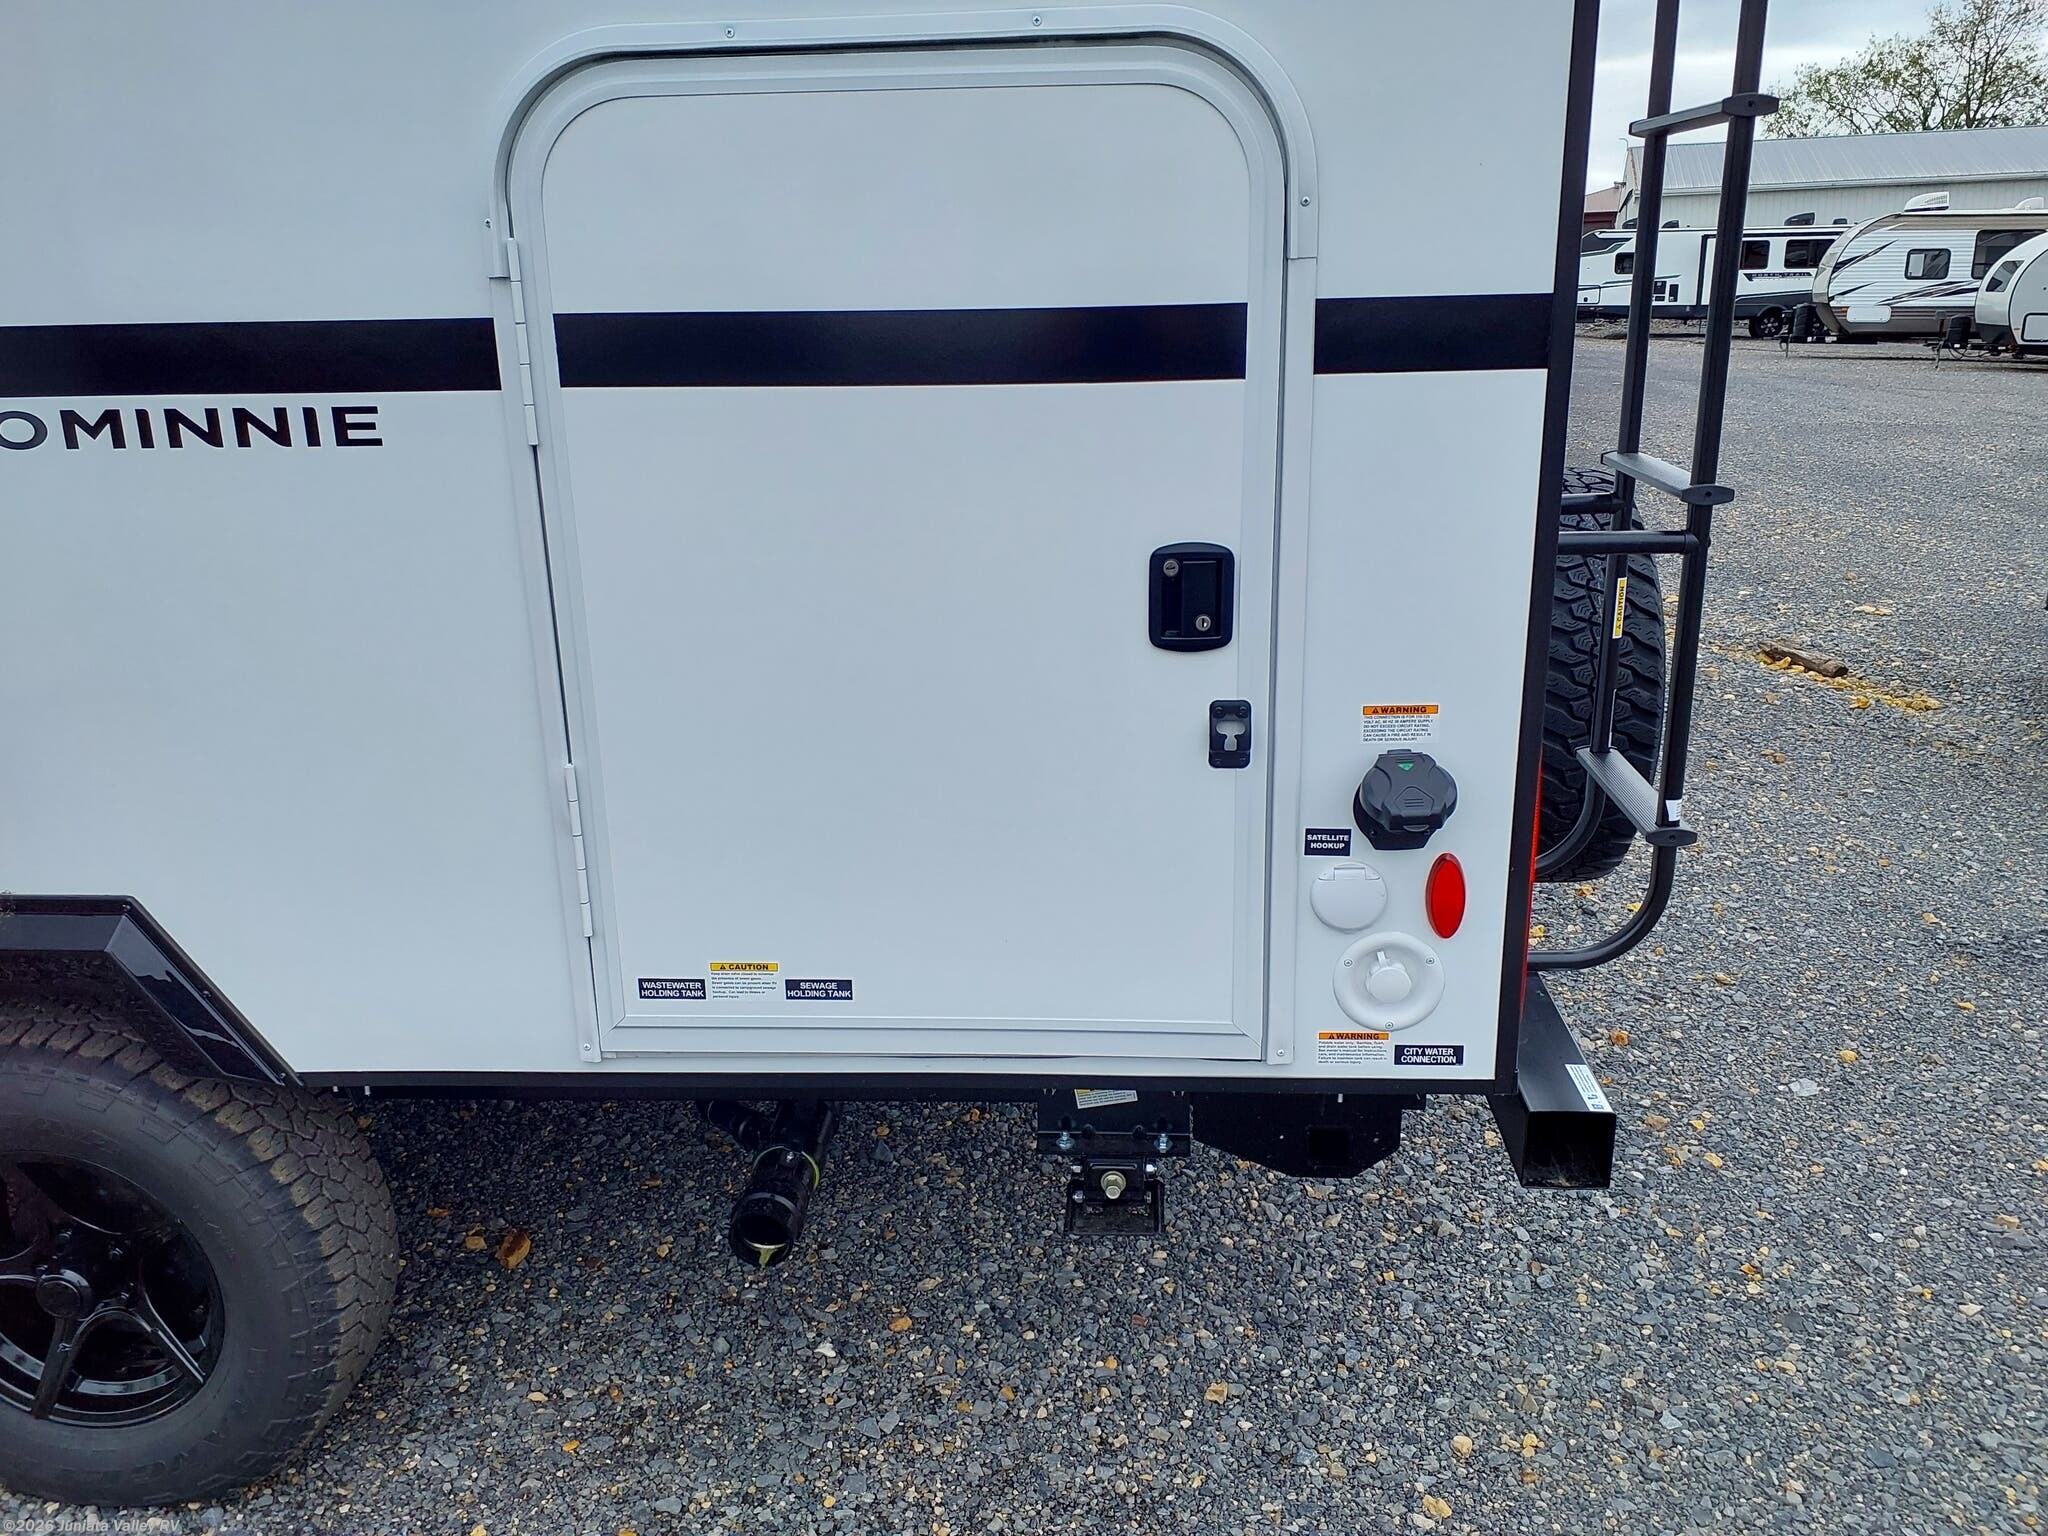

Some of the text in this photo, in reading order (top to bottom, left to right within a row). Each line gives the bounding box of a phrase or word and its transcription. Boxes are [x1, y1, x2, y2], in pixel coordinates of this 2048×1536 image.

[1380, 706, 1427, 714] WARNING
[642, 981, 702, 989] WASTEWATER
[641, 989, 680, 997] HOLDING
[680, 989, 704, 997] TANK
[828, 990, 851, 998] TANK
[1403, 1047, 1454, 1055] CITY WATER
[1400, 1055, 1457, 1063] CONNECTION
